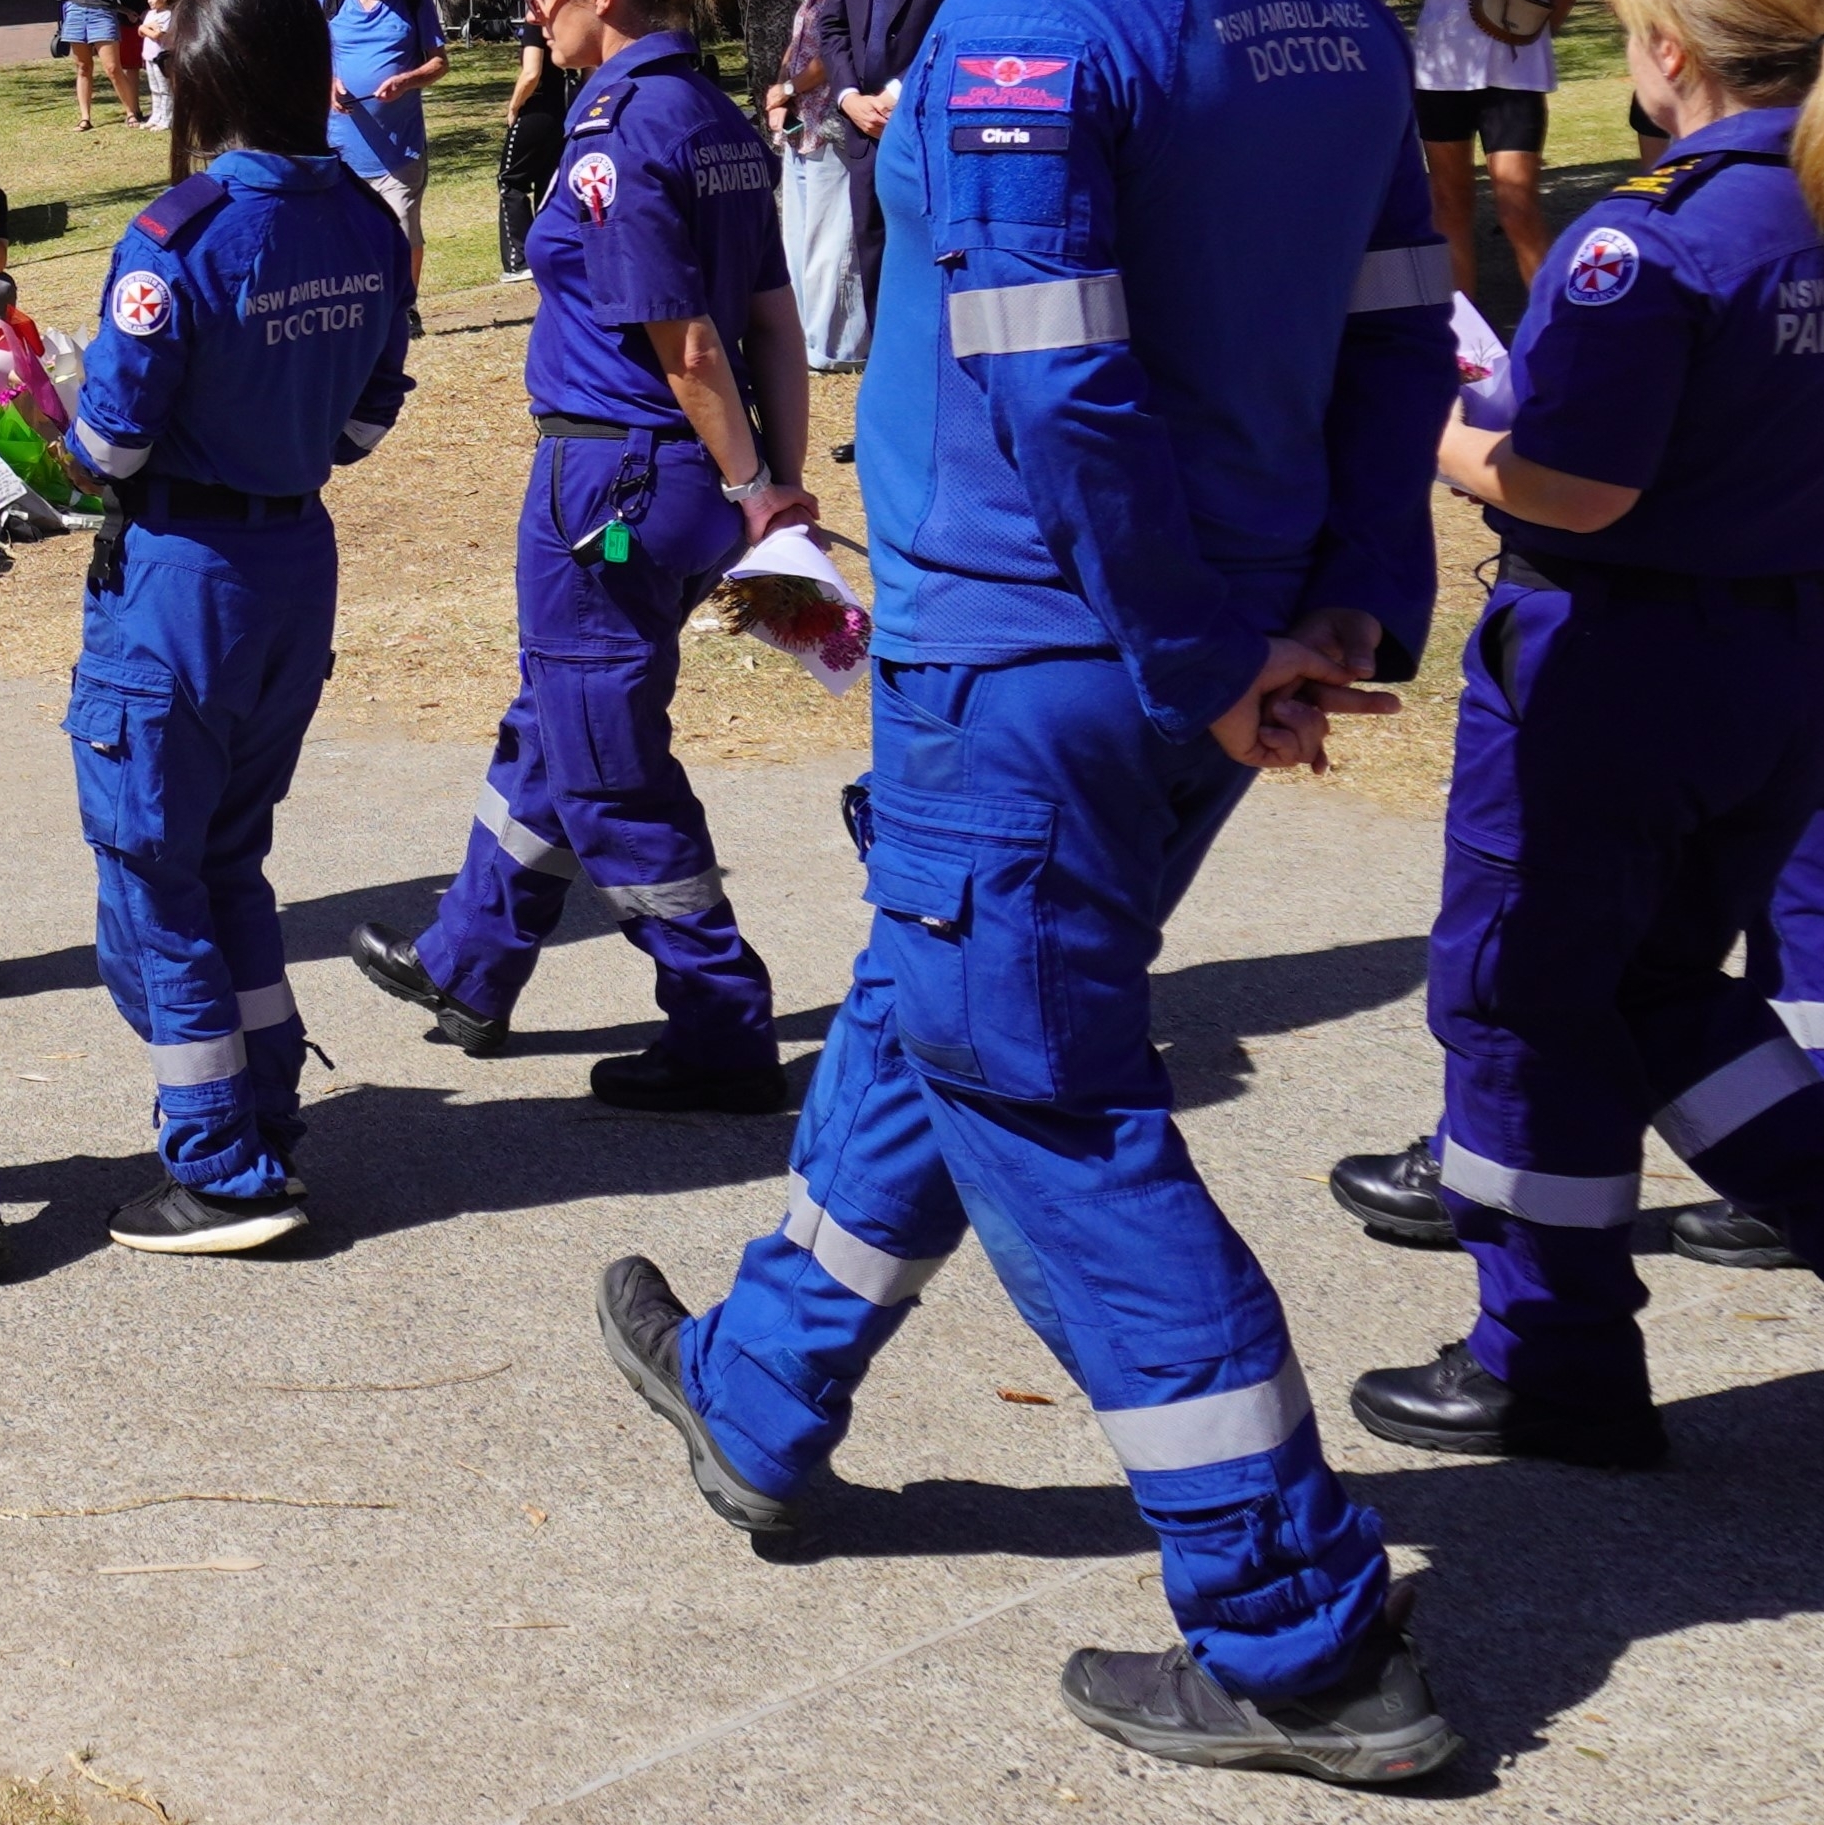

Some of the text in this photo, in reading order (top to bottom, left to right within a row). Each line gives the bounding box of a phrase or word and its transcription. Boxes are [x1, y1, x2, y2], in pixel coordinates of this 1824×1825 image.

[1213, 1, 1370, 44] NSW AMBULANCE
[1247, 36, 1367, 83] DOCTOR
[981, 128, 1030, 144] Chris
[245, 290, 285, 316] NSW
[267, 303, 365, 345] DOCTOR
